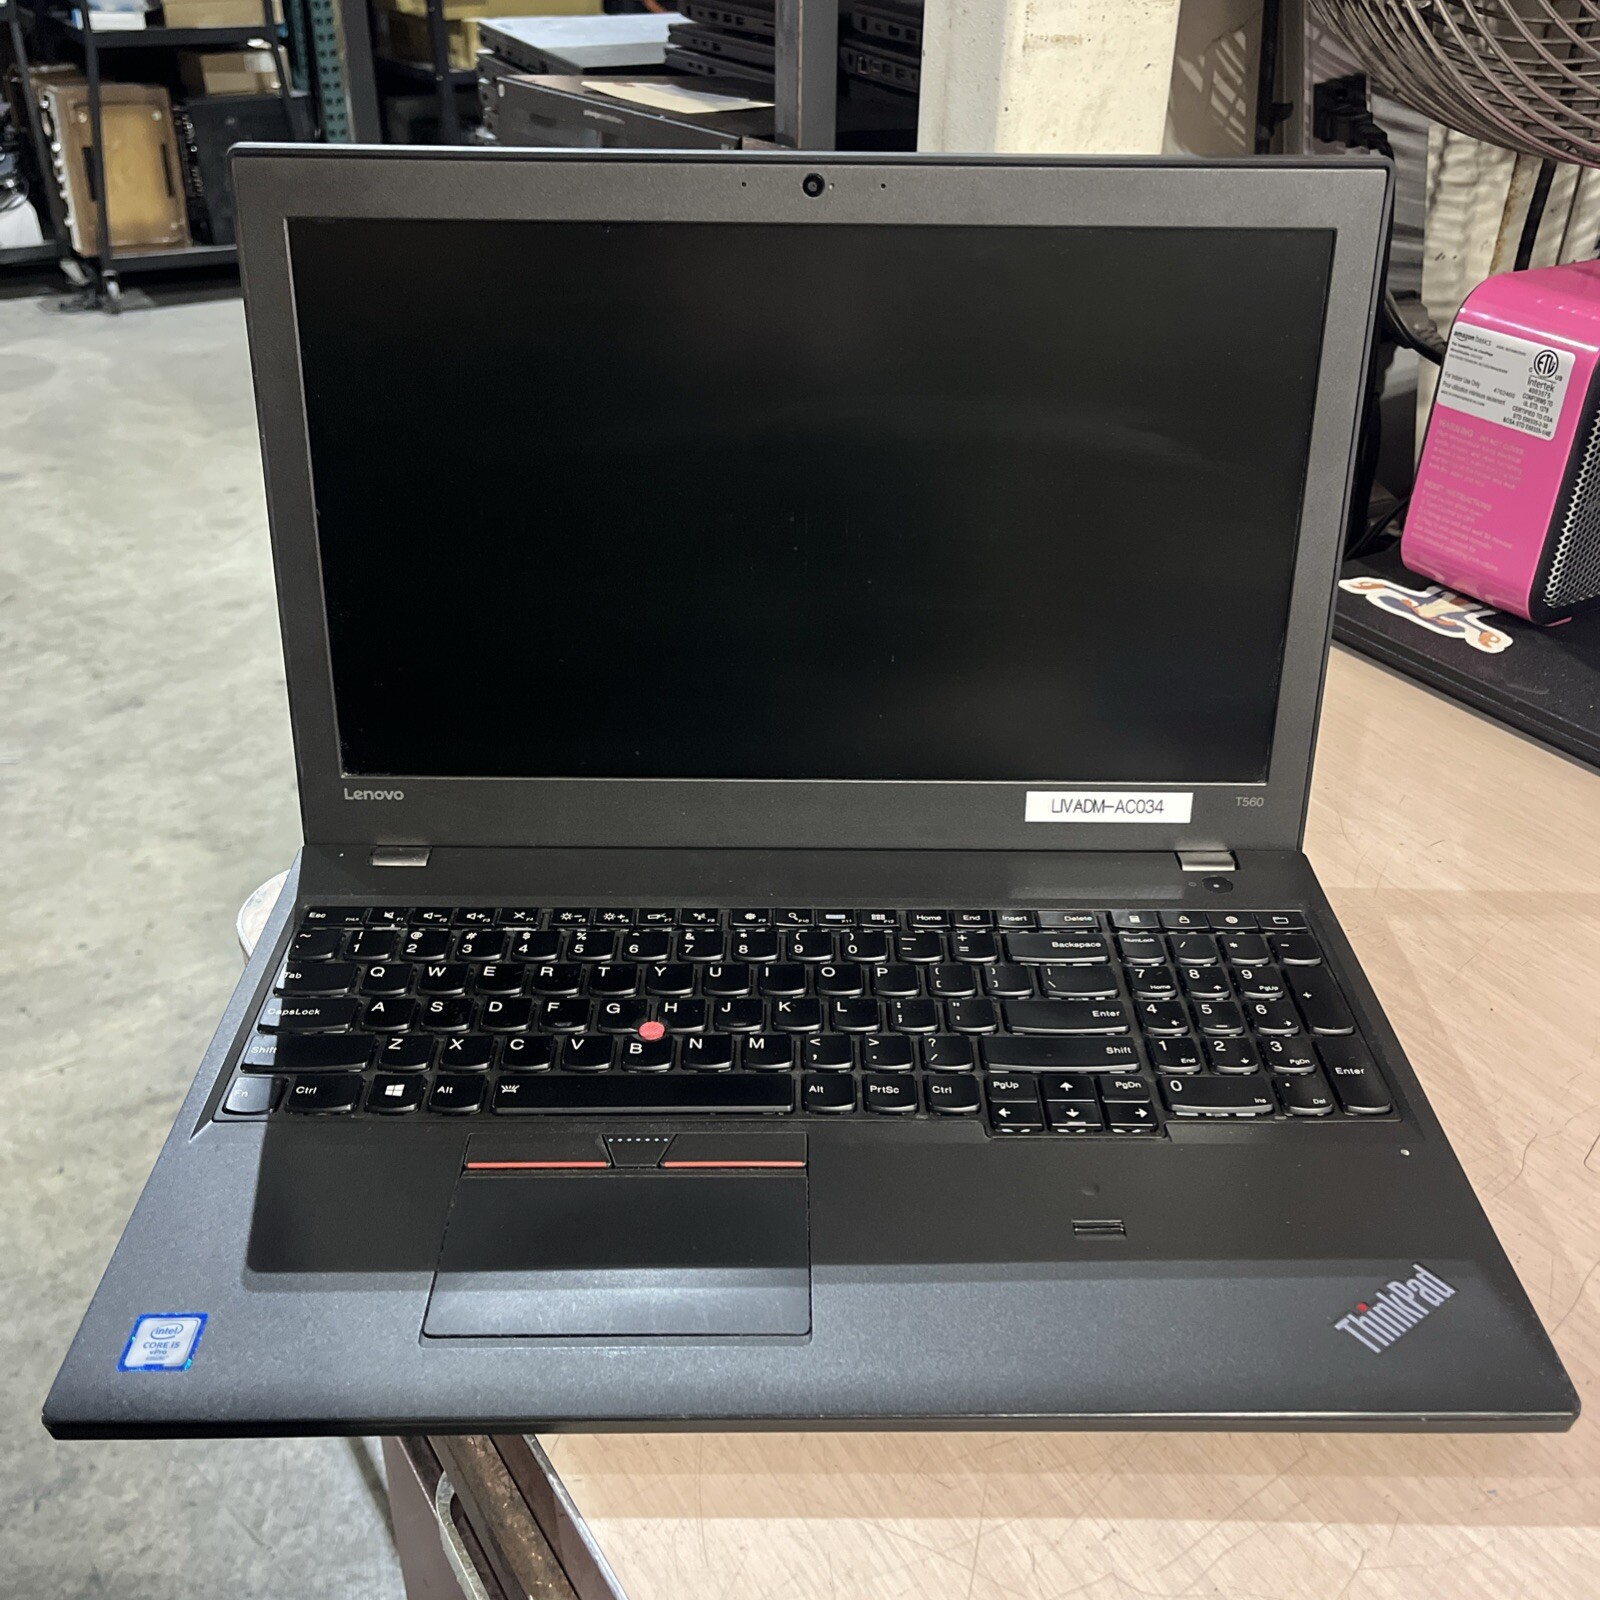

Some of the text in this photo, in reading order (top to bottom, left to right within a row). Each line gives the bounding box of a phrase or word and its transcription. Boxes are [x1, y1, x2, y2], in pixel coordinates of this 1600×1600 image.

[1454, 331, 1491, 346] amazon basics
[1528, 376, 1554, 392] Intertek
[1522, 393, 1546, 405] CONFORMS
[1512, 405, 1535, 417] CERTIFIED
[1536, 412, 1542, 420] TO
[344, 788, 404, 800] Lenovo
[1051, 799, 1164, 814] LIVADM-AC034
[1236, 797, 1264, 808] T560
[411, 932, 423, 940] @
[466, 932, 477, 940] #
[522, 932, 531, 940] $
[577, 932, 587, 940] %
[354, 944, 360, 952] 1
[406, 944, 417, 953] 2
[462, 944, 472, 953] 3
[519, 944, 528, 953] 4
[574, 944, 584, 953] 5
[629, 944, 638, 953] 6
[684, 944, 694, 953] 7
[739, 945, 748, 954] 8
[794, 944, 803, 953] 9
[370, 967, 385, 977] Q
[429, 966, 446, 977] W
[483, 966, 496, 976] E
[540, 966, 553, 977] R
[598, 966, 610, 977] T
[654, 966, 666, 976] Y
[710, 967, 721, 977] U
[821, 967, 835, 977] O
[877, 967, 888, 977] P
[1135, 969, 1145, 978] 7
[1189, 969, 1200, 979] 8
[1241, 969, 1252, 979] 9
[371, 1002, 384, 1012] A
[430, 1001, 443, 1012] S
[489, 1001, 503, 1012] D
[547, 1002, 560, 1012] F
[606, 1003, 620, 1014] G
[665, 1002, 677, 1012] H
[721, 1002, 731, 1012] J
[779, 1001, 791, 1012] K
[837, 1002, 847, 1012] L
[1147, 1004, 1157, 1013] 4
[1201, 1004, 1212, 1014] 5
[1256, 1004, 1267, 1014] 6
[268, 1008, 320, 1016] CapsLock
[388, 1038, 403, 1050] Z
[449, 1038, 464, 1050] X
[510, 1039, 524, 1050] C
[571, 1039, 584, 1050] V
[689, 1038, 702, 1049] N
[749, 1037, 764, 1049] M
[928, 1038, 936, 1047] ?
[1159, 1040, 1167, 1051] 1
[1214, 1041, 1226, 1051] 2
[1270, 1041, 1282, 1052] 3
[630, 1043, 642, 1054] B
[296, 1086, 317, 1094] Ctrl
[437, 1086, 453, 1094] Alt
[809, 1085, 823, 1093] Alt
[870, 1085, 899, 1094] PrtSc
[993, 1081, 1019, 1089] PgUp
[1115, 1081, 1141, 1089] PgDn
[1334, 1263, 1456, 1353] ThinkPad
[143, 1341, 180, 1349] CORE i5
